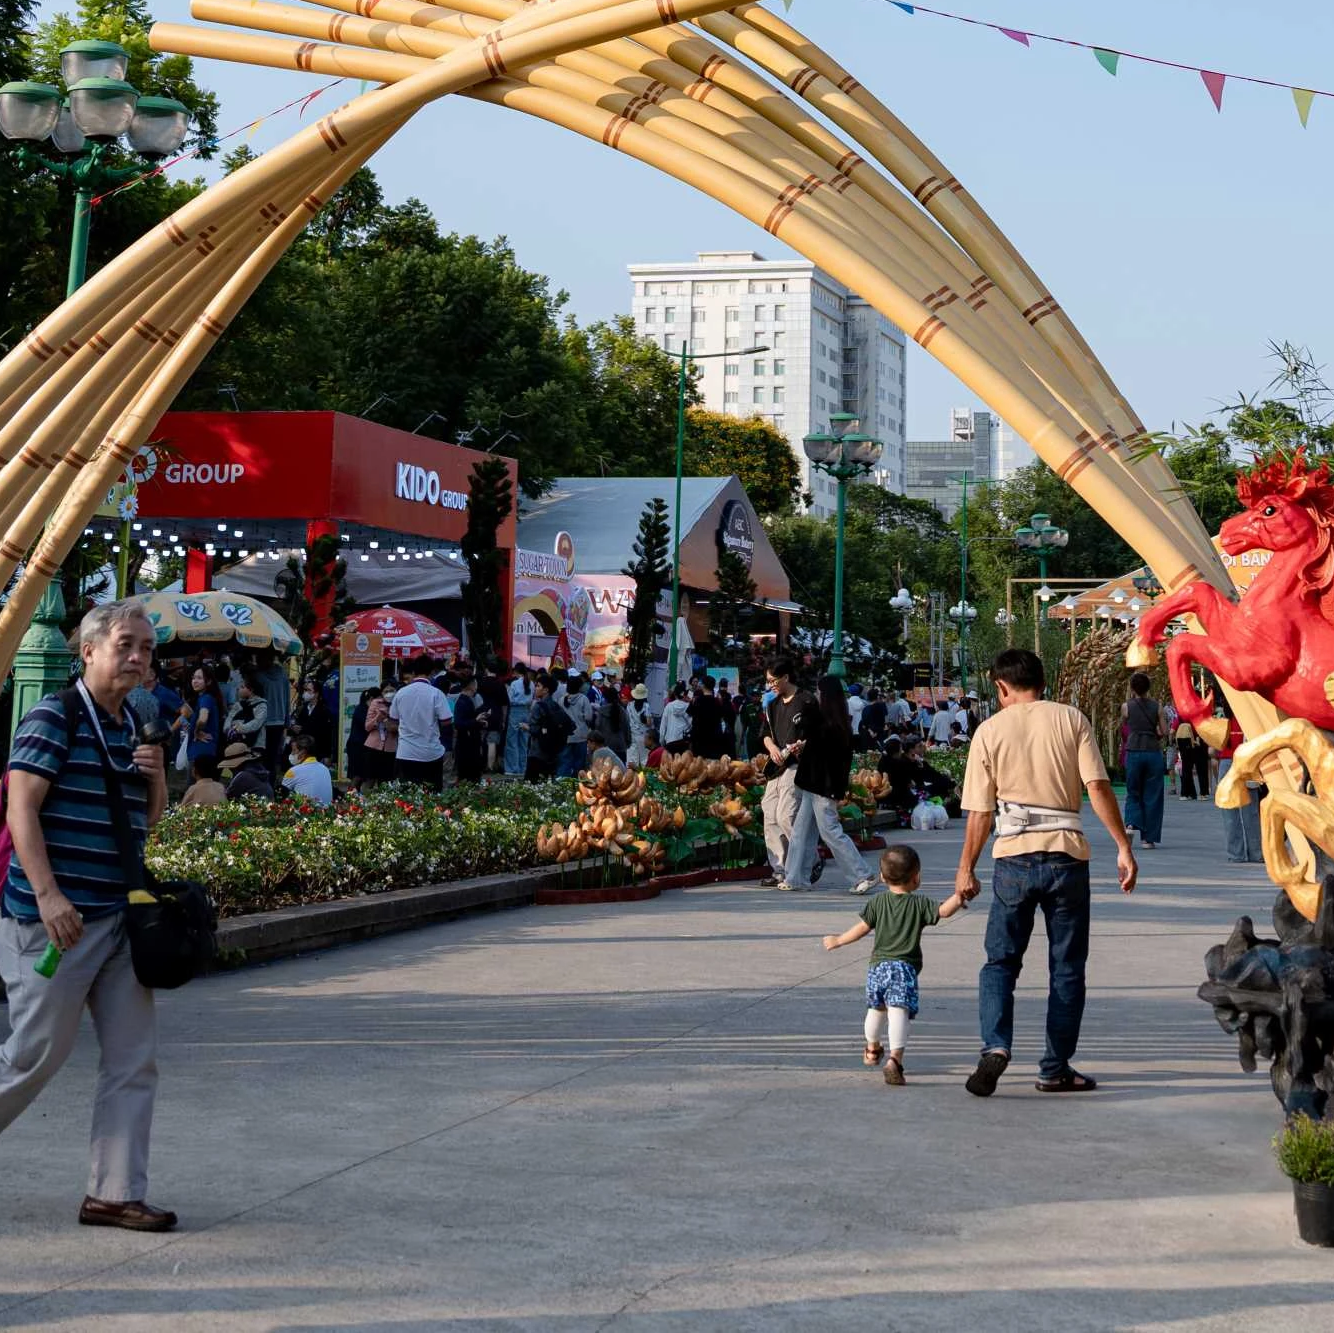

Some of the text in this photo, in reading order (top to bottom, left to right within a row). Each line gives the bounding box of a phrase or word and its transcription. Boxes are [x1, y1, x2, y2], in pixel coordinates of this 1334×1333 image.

[165, 463, 245, 484] GROUP
[396, 461, 440, 505] KIDO
[519, 552, 568, 577] SUGAR TOWN
[176, 600, 253, 626] C2 C2
